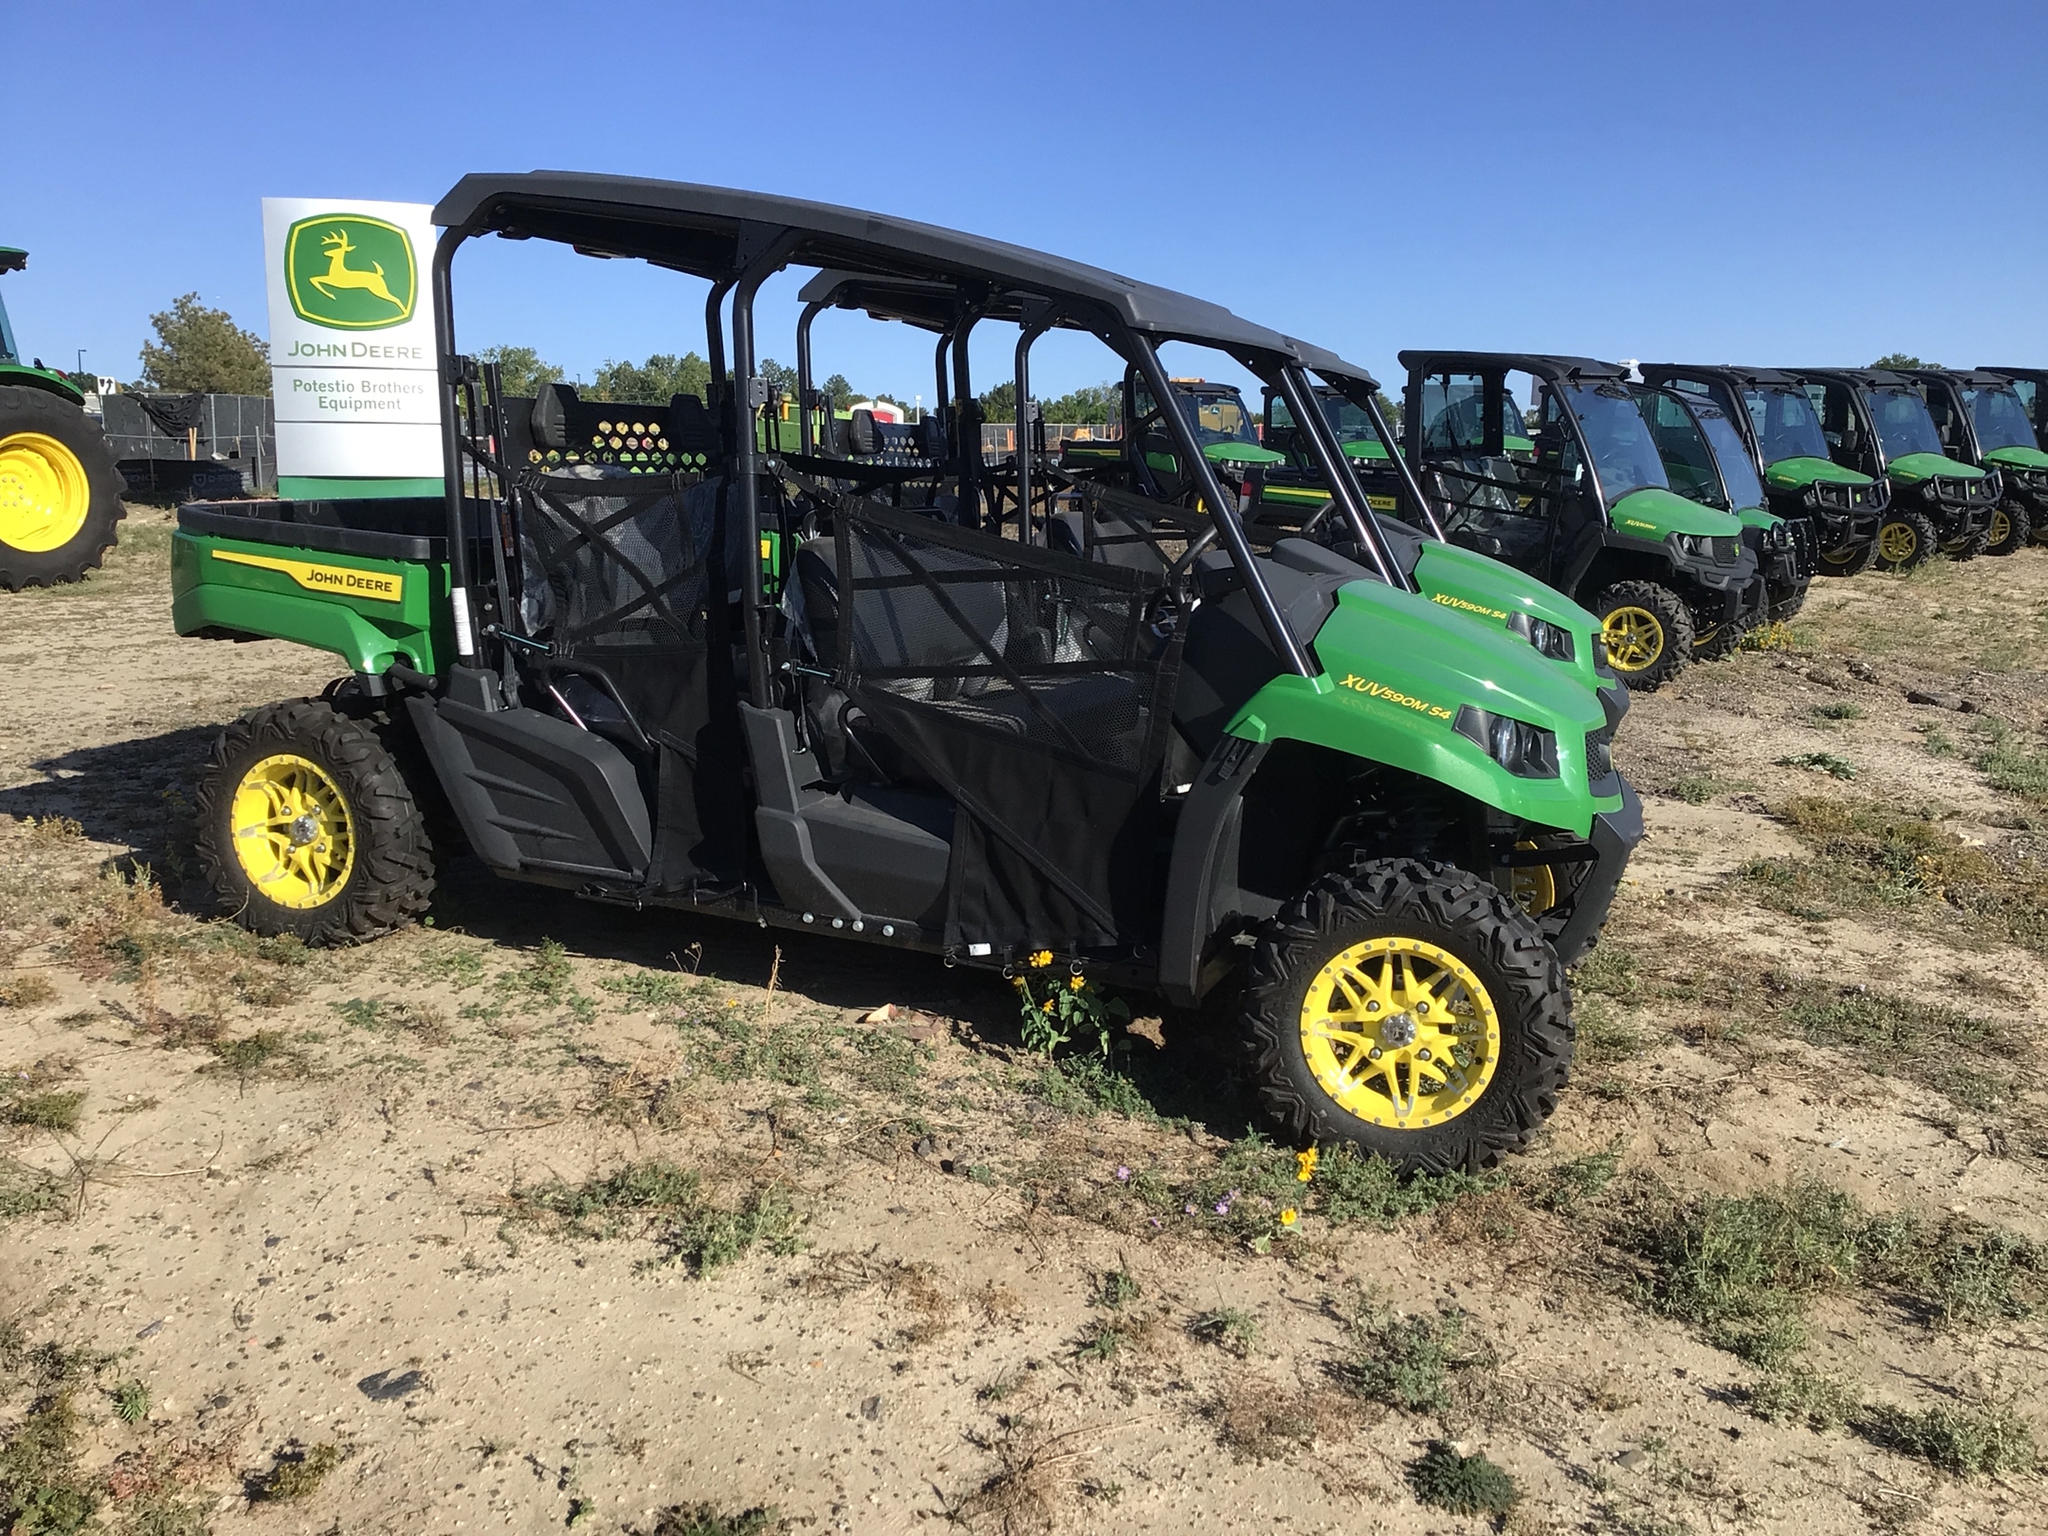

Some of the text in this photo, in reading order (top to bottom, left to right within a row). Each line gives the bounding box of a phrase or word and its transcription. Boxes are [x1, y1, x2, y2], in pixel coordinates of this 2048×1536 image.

[288, 340, 423, 359] JOHN DEERE
[293, 379, 424, 395] Potestio Brothers
[318, 396, 402, 412] Equipment
[306, 569, 393, 593] JOHN DEERE
[1431, 593, 1508, 619] XUV590M S4
[1338, 674, 1453, 720] XUV590M S4
